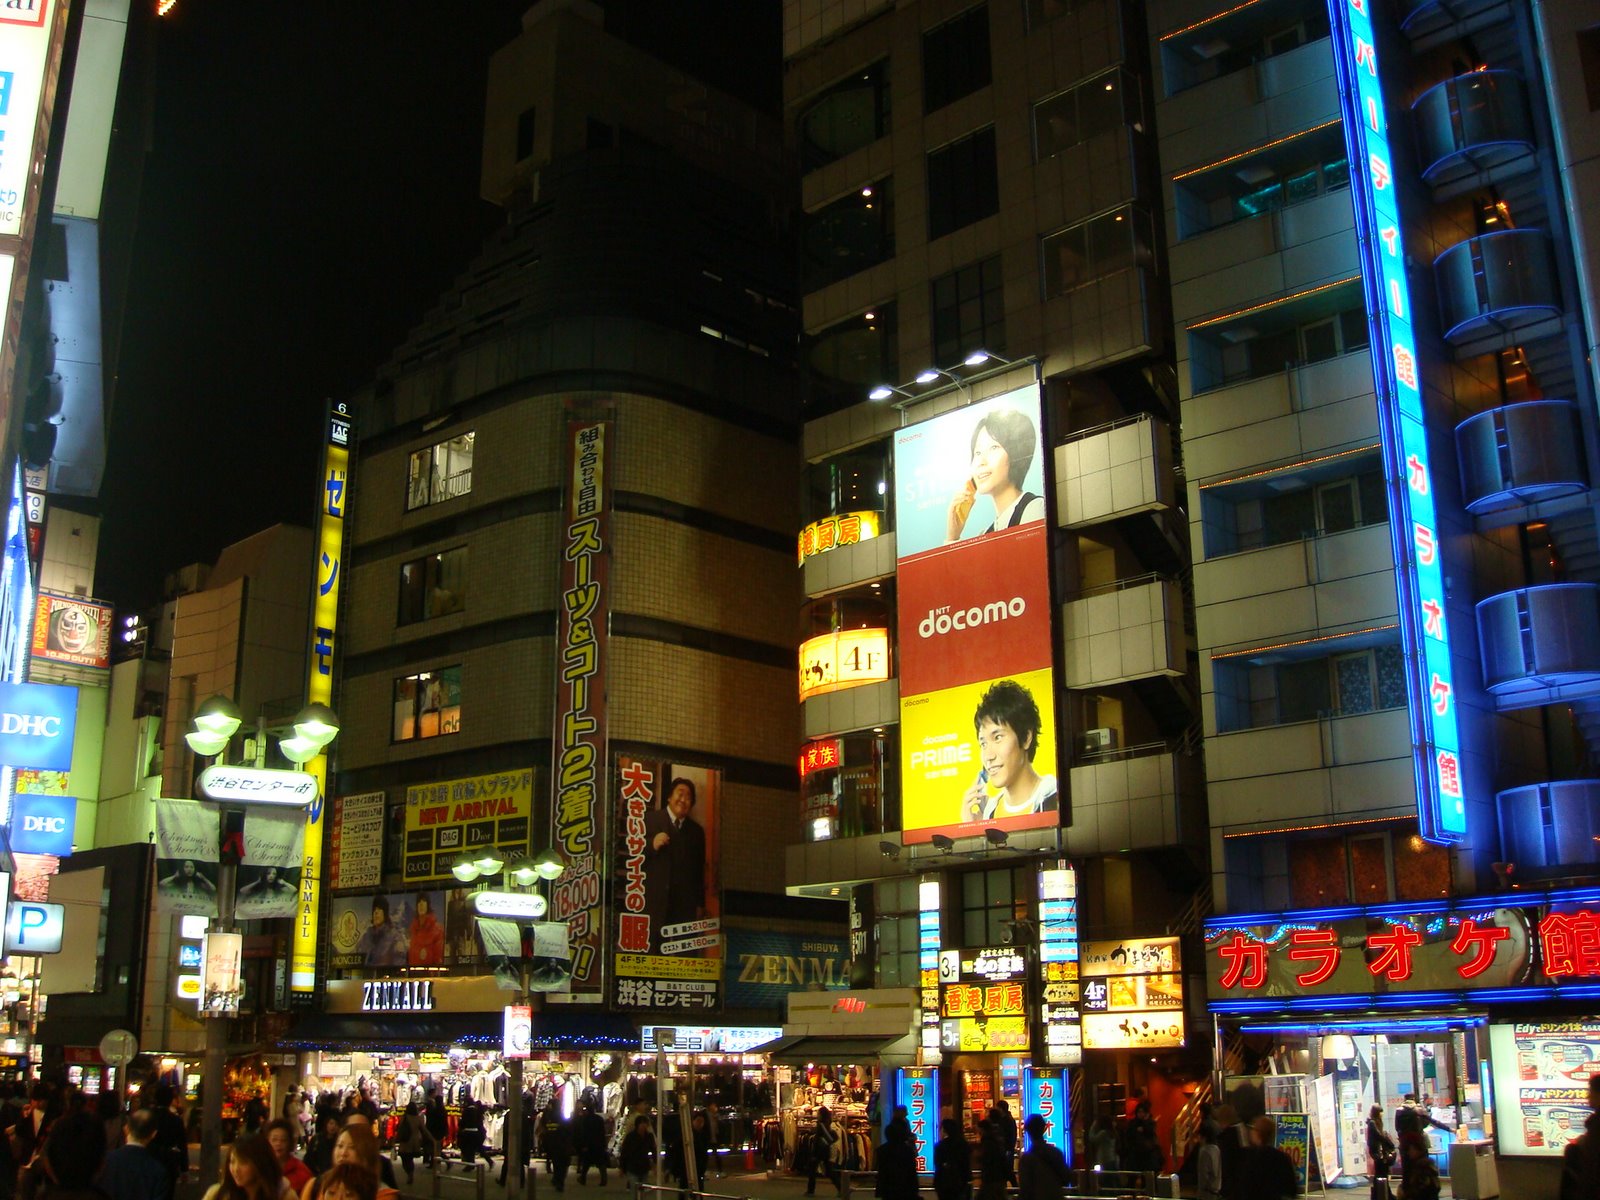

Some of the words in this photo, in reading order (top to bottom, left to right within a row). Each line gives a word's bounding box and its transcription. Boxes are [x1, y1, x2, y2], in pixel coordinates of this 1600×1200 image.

[578, 426, 599, 517] 組み合わせ自由
[918, 597, 1026, 638] docomo
[935, 605, 951, 616] NTT
[1406, 455, 1459, 796] カラオケ館
[844, 646, 881, 672] 4F
[903, 697, 930, 708] docomo
[1, 713, 61, 737] DHC
[910, 743, 972, 769] PRIME
[207, 775, 312, 797] 渋谷センター街
[419, 806, 449, 826] NEW
[452, 796, 518, 822] ARRIVAL
[24, 814, 65, 834] DHC
[442, 831, 458, 841] D&G
[471, 828, 491, 842] Dior
[407, 862, 430, 873] GUCCI
[302, 856, 314, 939] ZENMALL
[552, 871, 600, 922] 18,000
[18, 906, 48, 945] P
[801, 942, 840, 954] SHIBUYA
[737, 953, 853, 987] ZENMA
[941, 957, 957, 978] 3F
[362, 980, 432, 1010] ZENMALL
[618, 979, 716, 1008] 渋谷ゼンモール
[685, 983, 706, 991] CLUB
[947, 985, 1024, 1012] 香港厨房
[1083, 981, 1107, 1000] 4F
[942, 1022, 960, 1047] 5F
